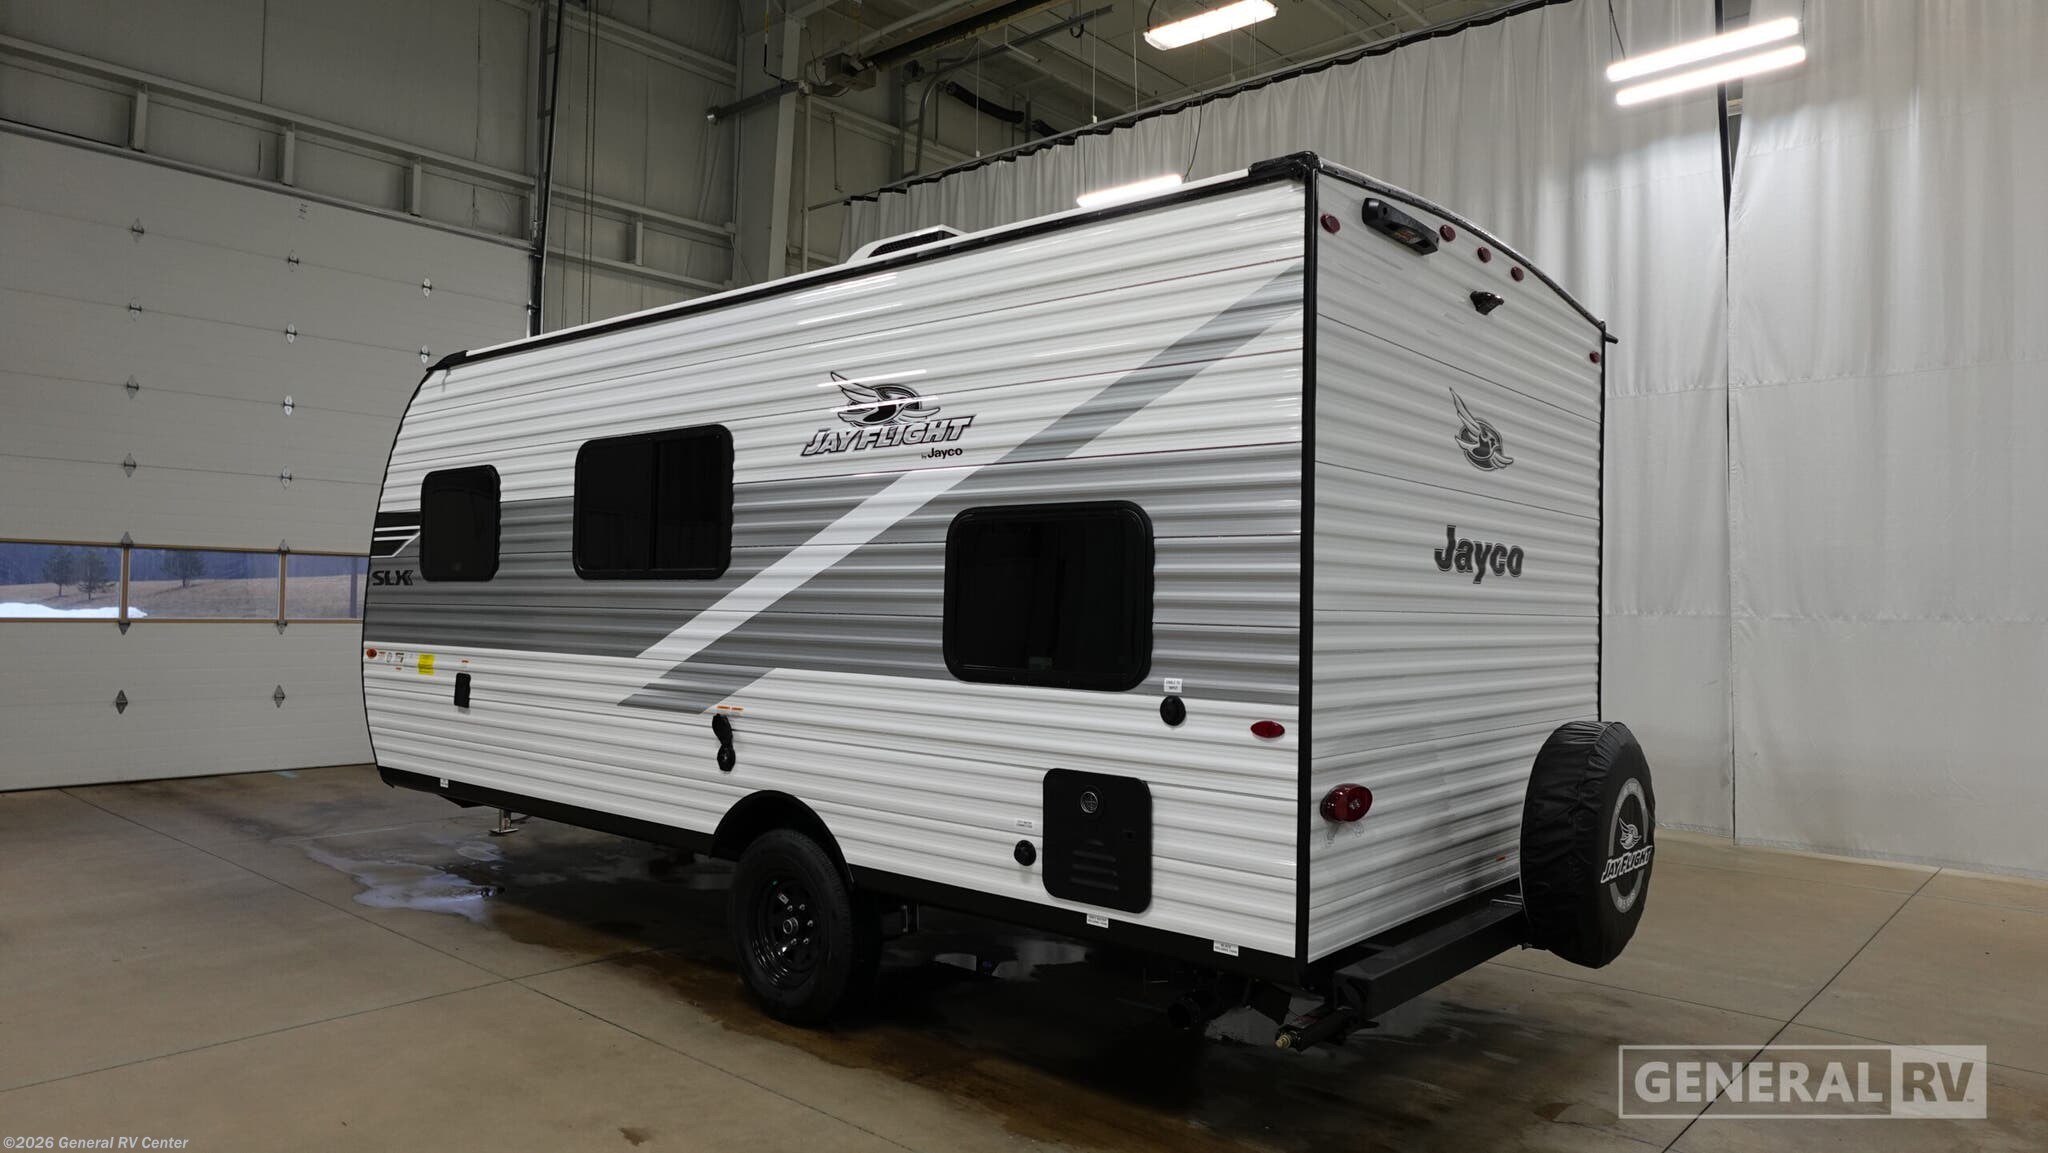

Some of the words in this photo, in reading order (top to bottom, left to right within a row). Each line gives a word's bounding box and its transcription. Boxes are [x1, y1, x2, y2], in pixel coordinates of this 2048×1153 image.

[927, 447, 963, 460] Jayco
[1434, 524, 1524, 584] Jayco
[372, 570, 414, 586] SLK
